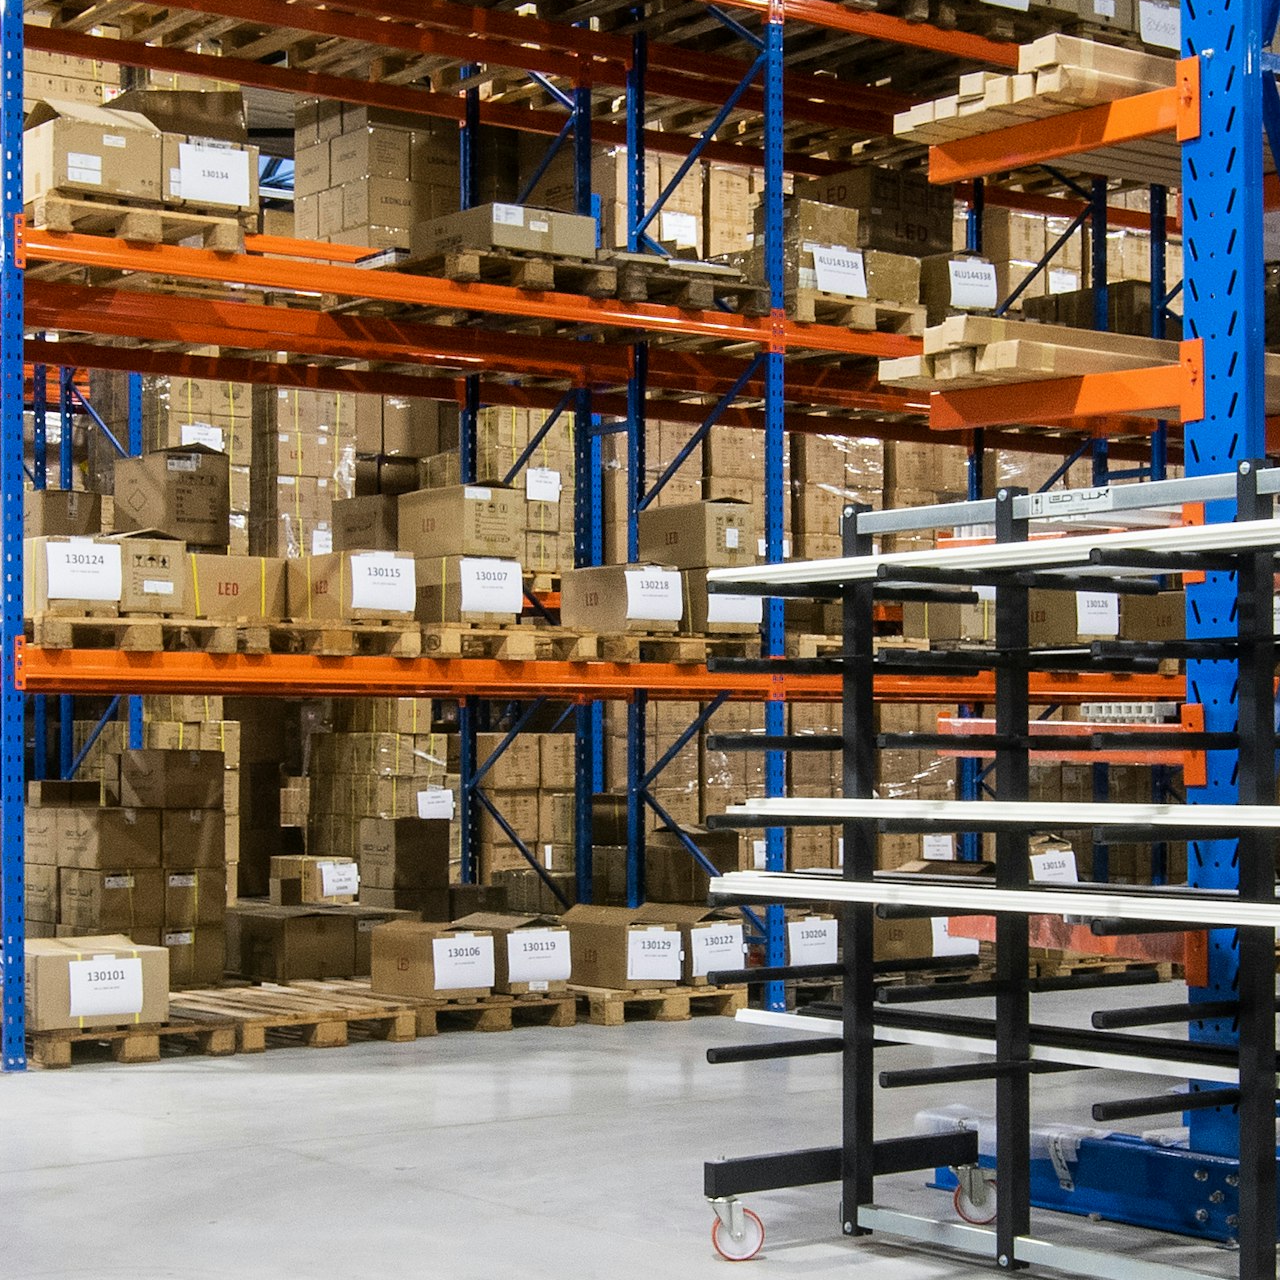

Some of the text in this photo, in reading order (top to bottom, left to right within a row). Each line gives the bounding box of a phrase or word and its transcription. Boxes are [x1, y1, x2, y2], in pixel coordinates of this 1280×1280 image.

[202, 169, 229, 180] 130134
[894, 222, 928, 242] LED
[290, 407, 304, 417] LD
[290, 493, 304, 503] LD
[665, 531, 678, 545] LED
[65, 554, 104, 566] 130124
[367, 567, 401, 578] 130115
[475, 571, 508, 582] 130107
[218, 581, 239, 596] LED
[315, 580, 329, 595] LED
[640, 580, 669, 590] 130218
[585, 592, 599, 607] LED
[1086, 599, 1109, 608] 130126
[1030, 610, 1046, 623] LED
[1157, 615, 1172, 627] LED
[1042, 860, 1066, 870] 130116
[800, 929, 827, 939] 130204
[888, 928, 905, 941] LED
[641, 940, 672, 950] 130129
[704, 935, 734, 946] 130122
[448, 946, 481, 957] 130106
[523, 941, 556, 952] 130119
[87, 969, 125, 982] 130101
